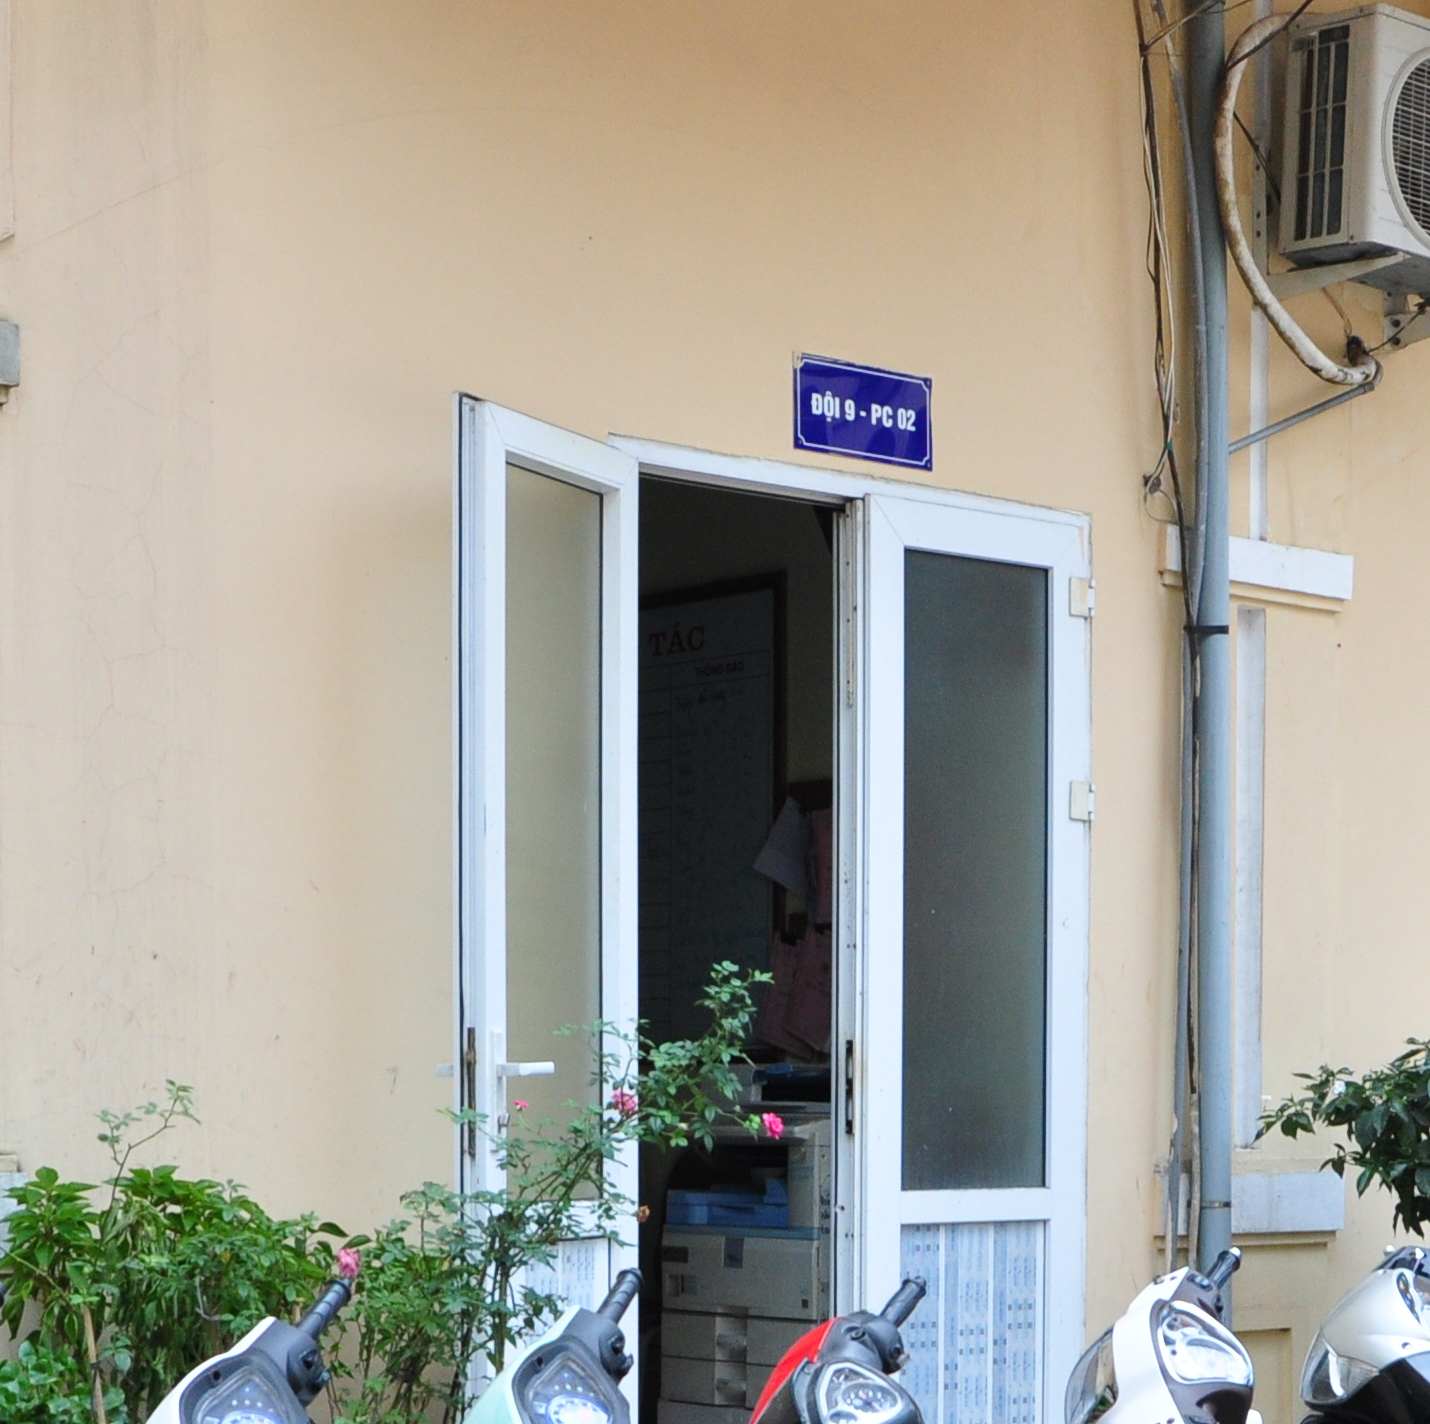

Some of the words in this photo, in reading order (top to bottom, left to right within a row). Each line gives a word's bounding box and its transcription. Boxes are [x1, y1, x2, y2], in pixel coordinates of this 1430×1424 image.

[811, 391, 840, 422] ĐỘI
[844, 399, 856, 421] 9
[871, 403, 893, 428] PC
[897, 408, 916, 432] 02
[648, 621, 705, 656] TÁC
